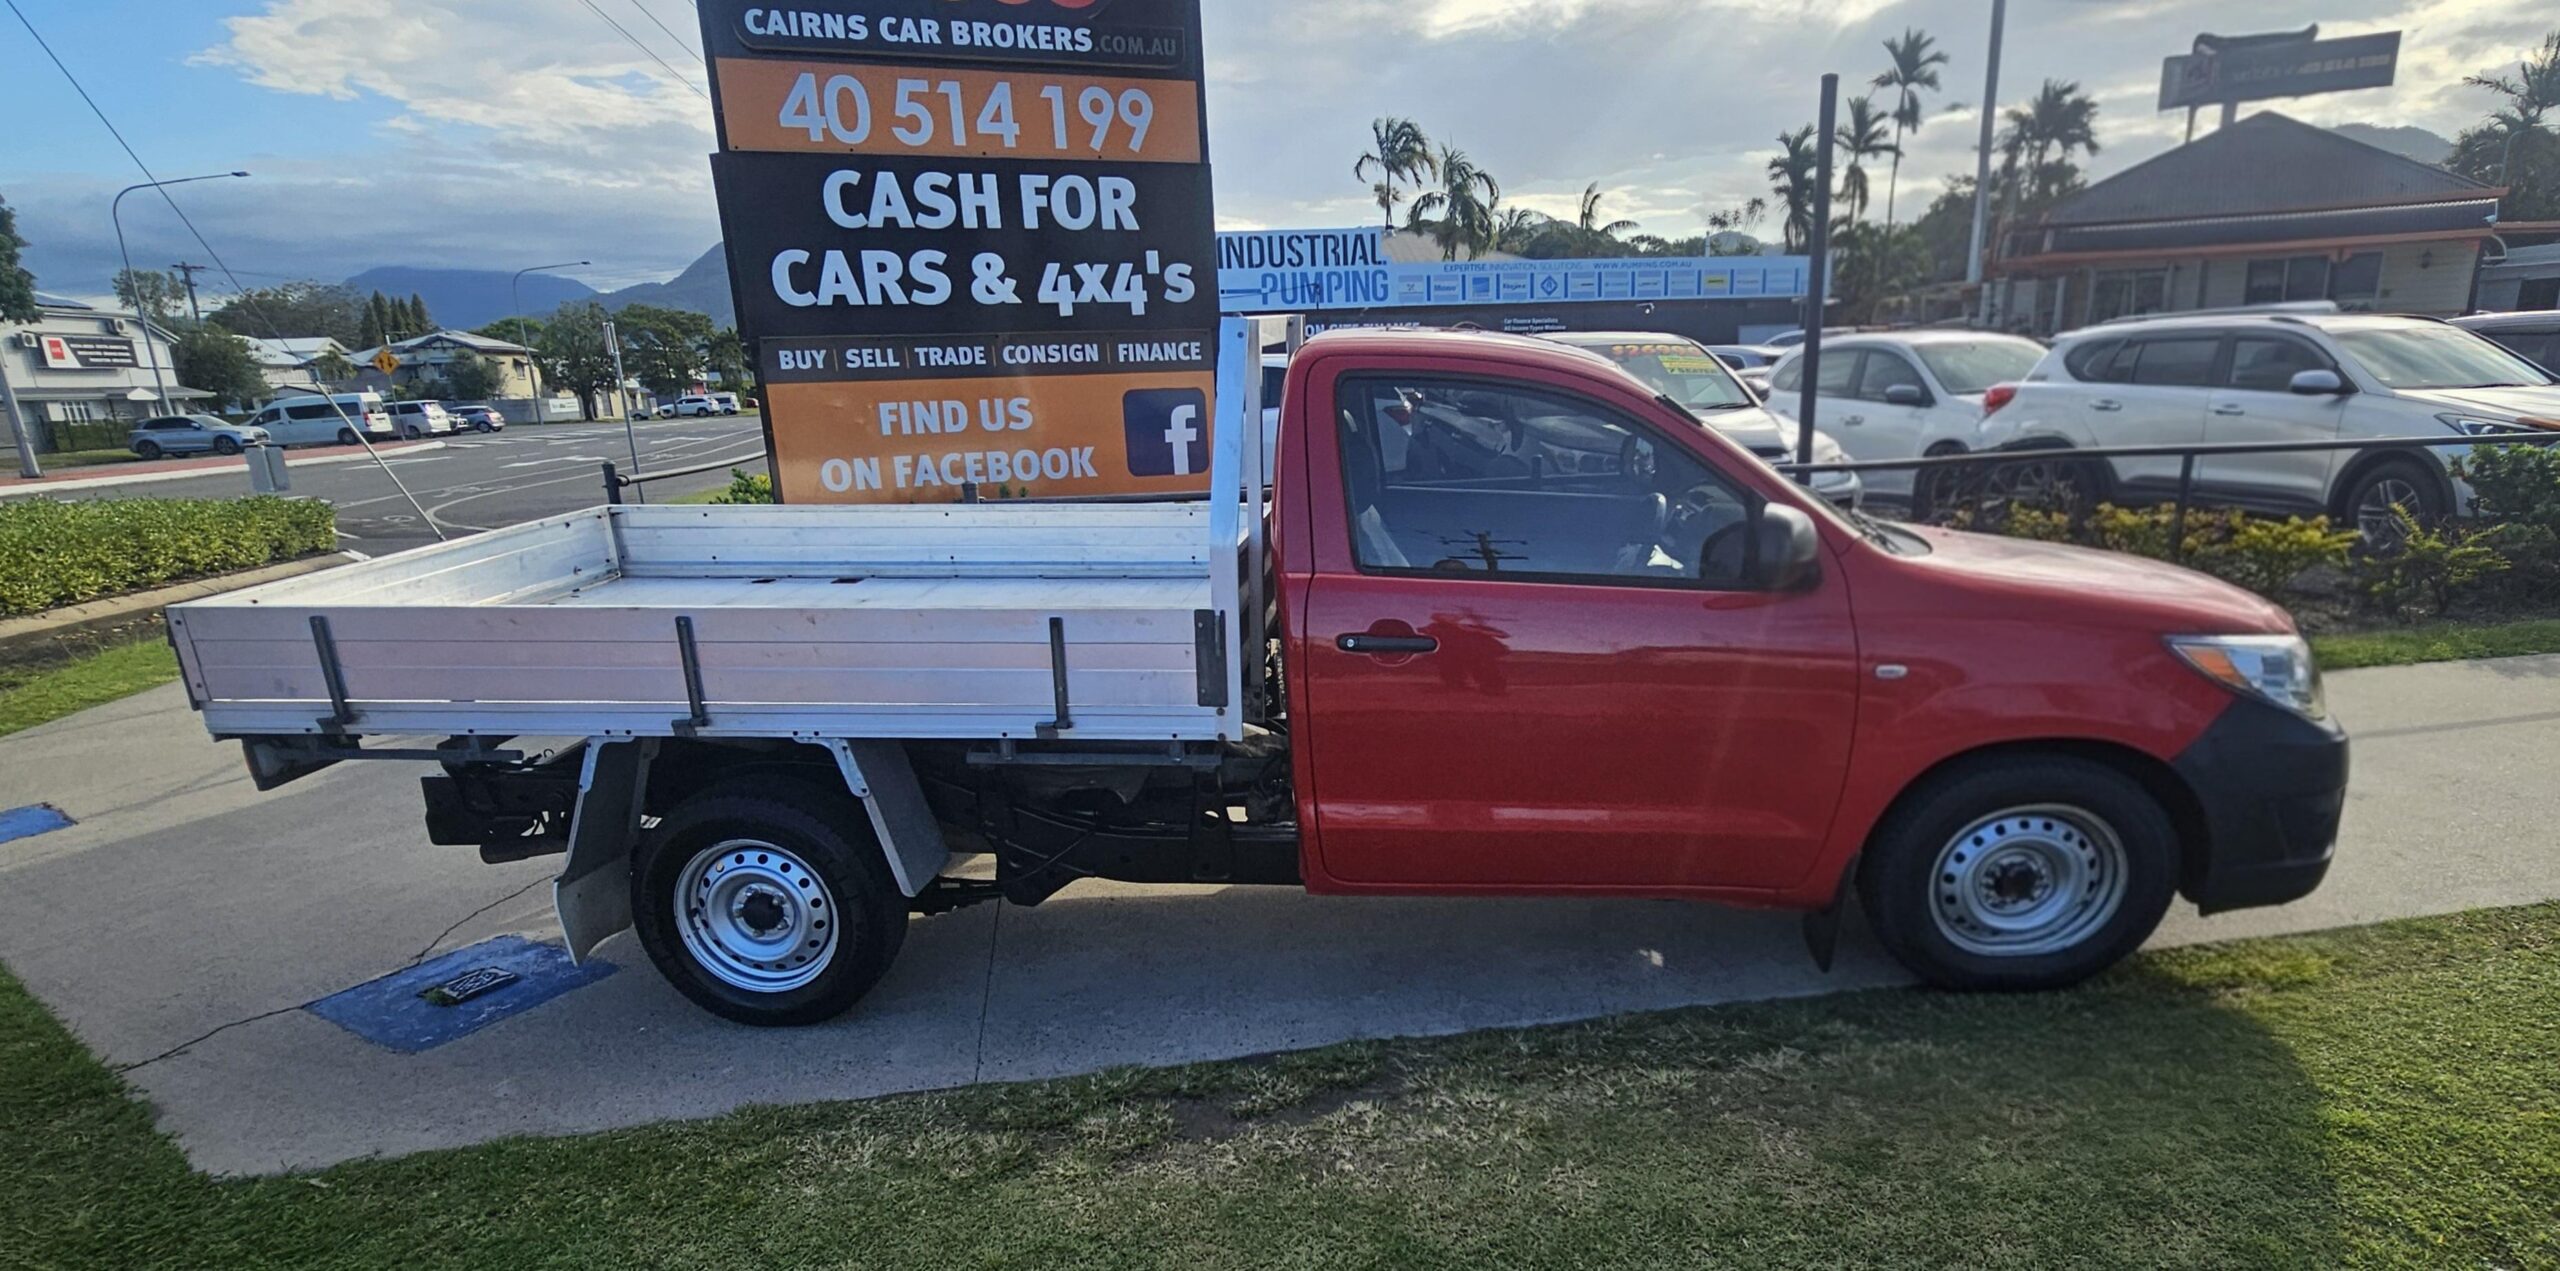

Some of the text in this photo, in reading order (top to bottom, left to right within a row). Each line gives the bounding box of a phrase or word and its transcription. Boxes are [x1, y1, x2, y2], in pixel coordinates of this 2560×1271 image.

[744, 8, 869, 42] CAIRNS
[879, 16, 943, 45] CAR
[779, 72, 1154, 153] 40 514 199
[823, 169, 1140, 231] CASH FOR
[771, 249, 952, 307] CARS
[970, 252, 1022, 305] &
[1261, 270, 1389, 306] PUMPING
[779, 341, 1202, 371] BUY SELL TRADE CONSIGN FINANCE
[878, 397, 1033, 437] FIND US
[820, 446, 1099, 493] ON FACEBOOK
